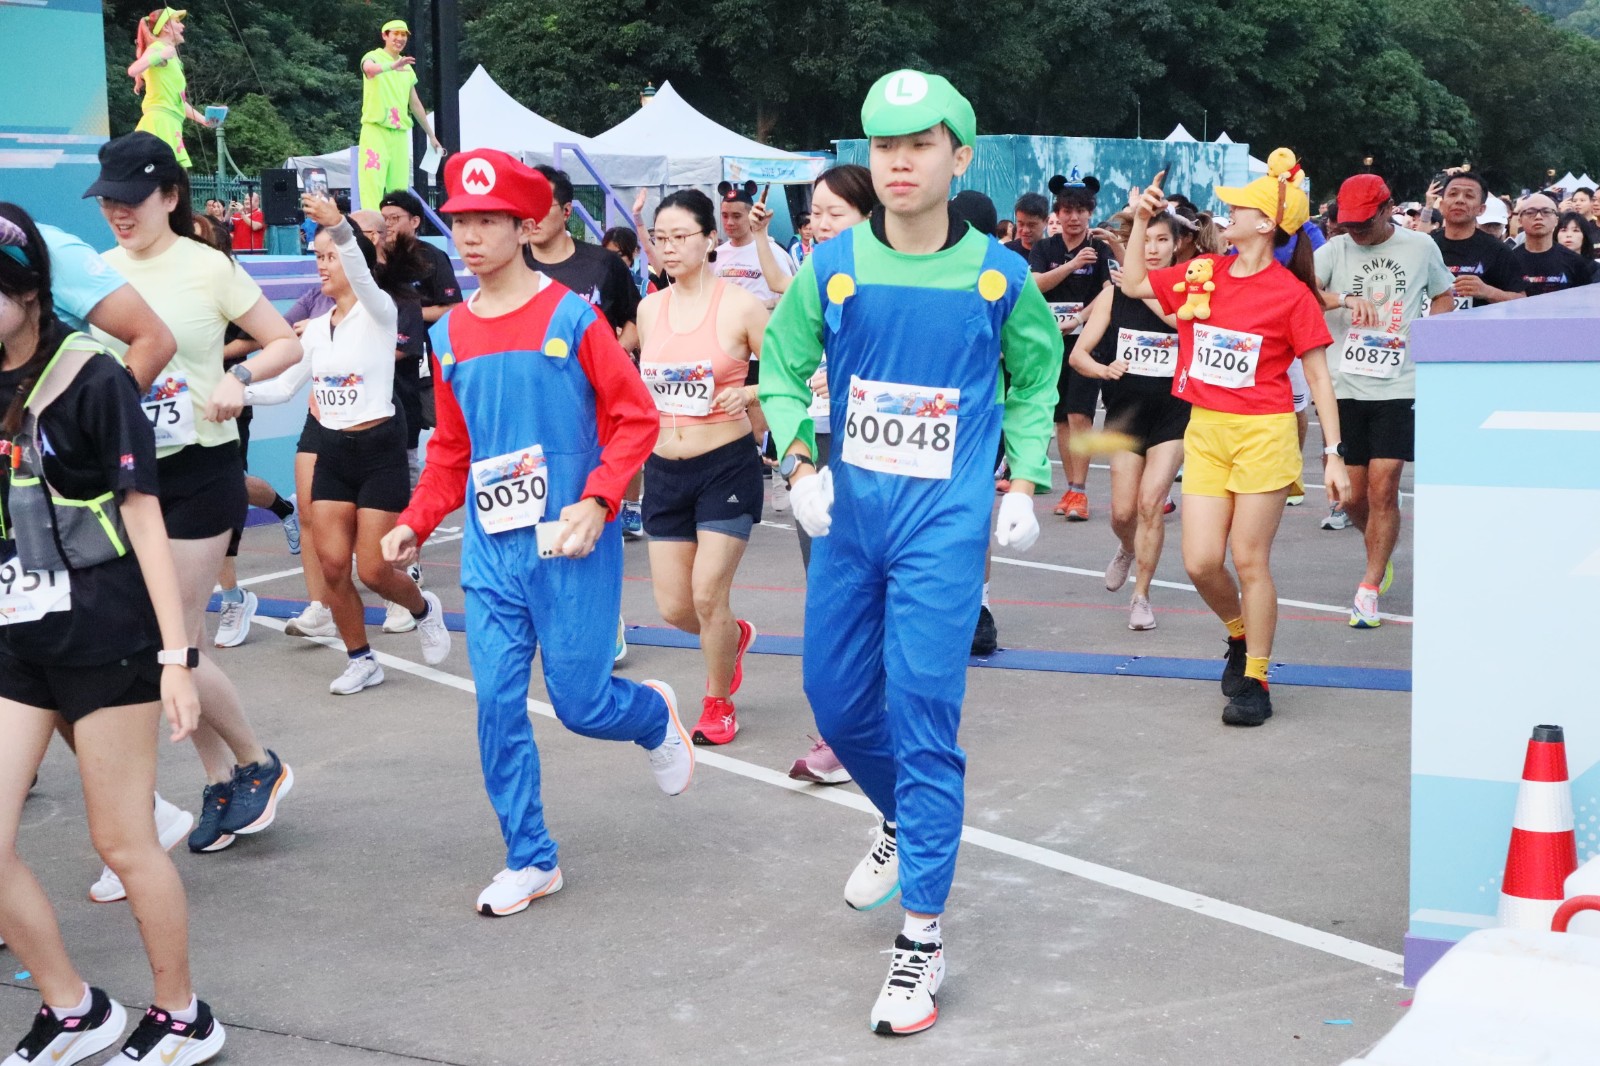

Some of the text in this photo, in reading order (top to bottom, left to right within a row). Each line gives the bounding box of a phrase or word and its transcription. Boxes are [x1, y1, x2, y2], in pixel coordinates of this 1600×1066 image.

[896, 77, 913, 98] L
[465, 167, 490, 187] M
[1352, 257, 1406, 297] RUN ANYWHERE
[1123, 346, 1170, 365] 61912
[1197, 346, 1249, 373] 61206
[1345, 345, 1401, 366] 60873
[846, 411, 950, 452] 60048
